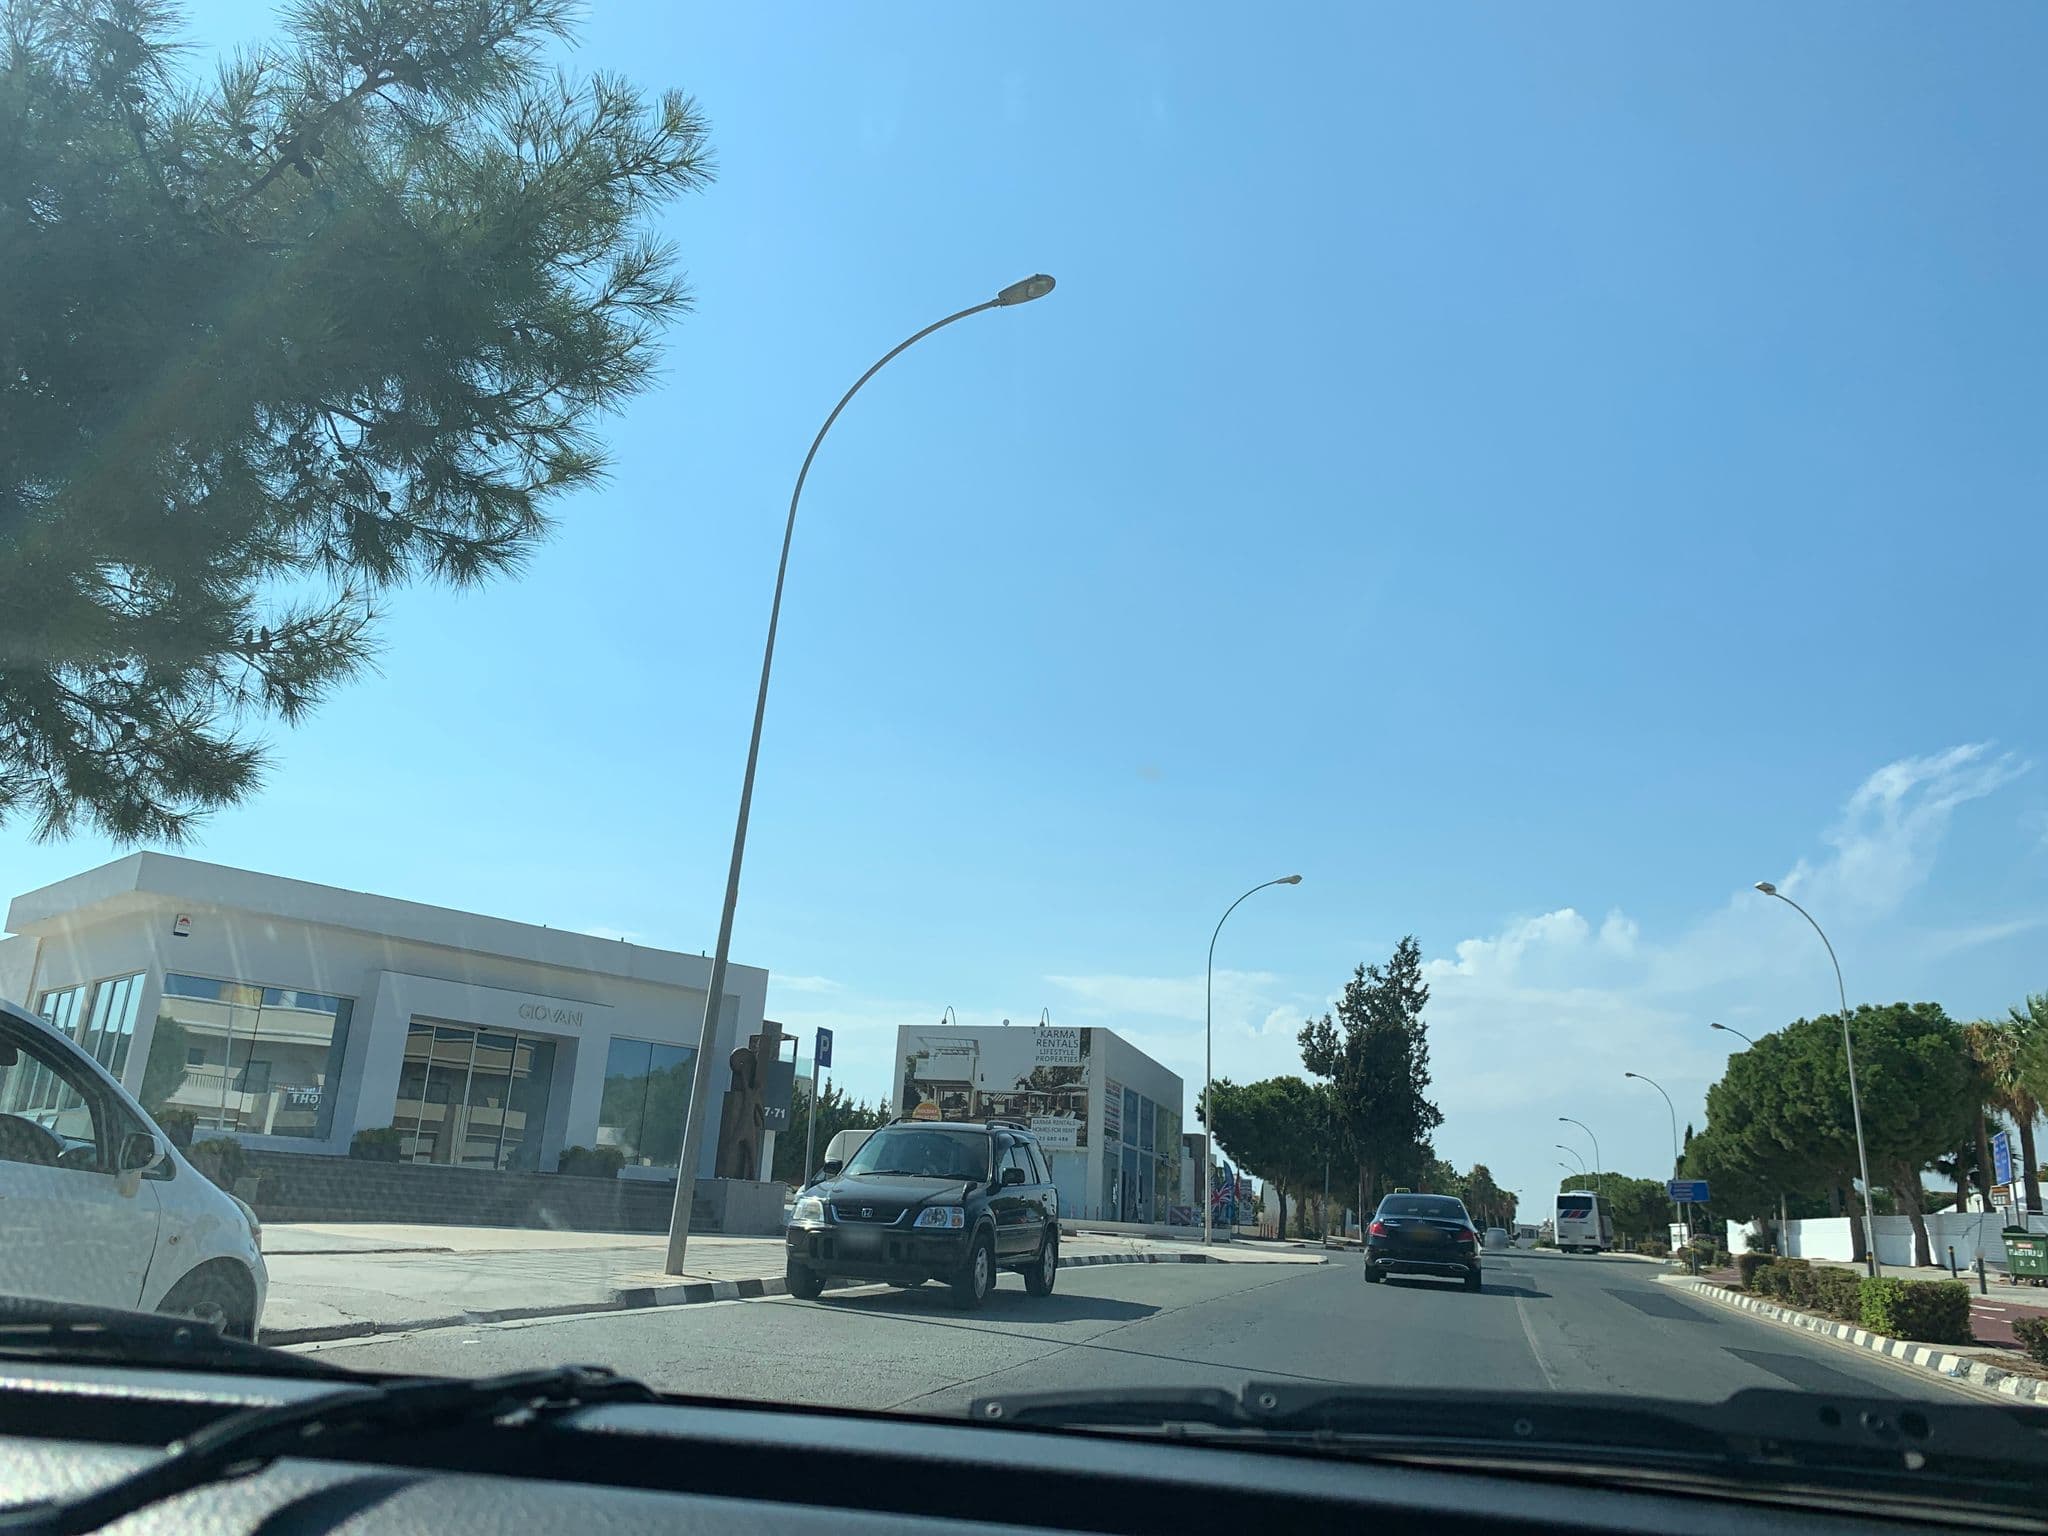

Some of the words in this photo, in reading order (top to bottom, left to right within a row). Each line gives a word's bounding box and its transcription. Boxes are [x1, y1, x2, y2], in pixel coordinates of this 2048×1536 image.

[519, 1003, 583, 1027] GIOVANI
[1040, 1029, 1076, 1039] KARMA
[819, 1034, 830, 1060] P
[1036, 1038, 1079, 1048] RENTALS
[1039, 1048, 1077, 1056] LIFESTYLE
[1035, 1055, 1079, 1063] PROPERTIES
